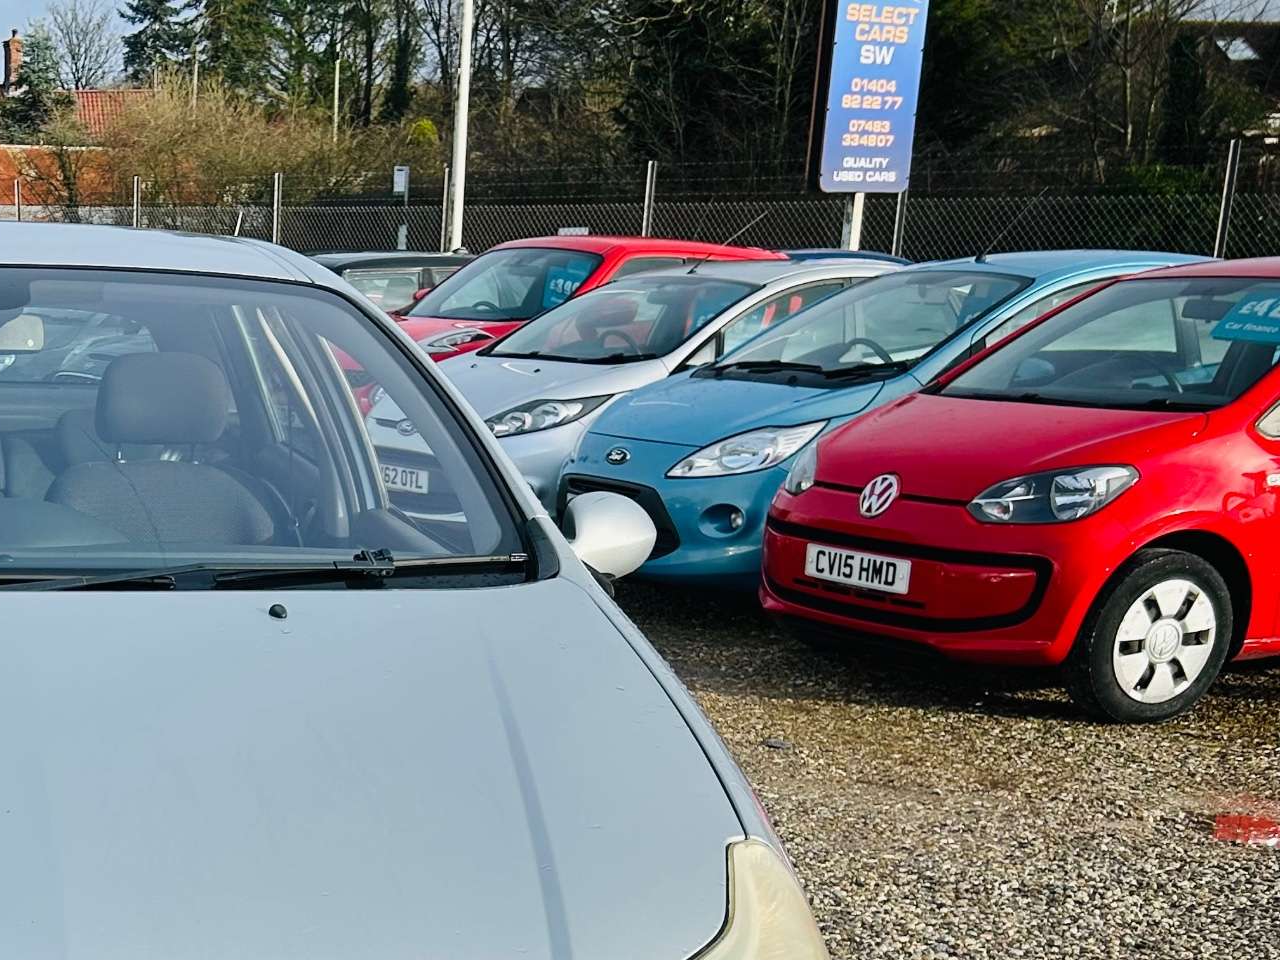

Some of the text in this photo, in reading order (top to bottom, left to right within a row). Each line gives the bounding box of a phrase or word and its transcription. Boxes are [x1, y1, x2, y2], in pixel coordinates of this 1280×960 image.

[846, 4, 918, 25] SELECT
[855, 24, 908, 44] CARS
[860, 44, 895, 65] SW
[851, 78, 896, 93] 01404
[842, 156, 889, 169] QUALITY
[833, 170, 896, 182] USED CARS
[380, 466, 423, 490] 62 OTL
[815, 550, 897, 587] CV15 HMD
